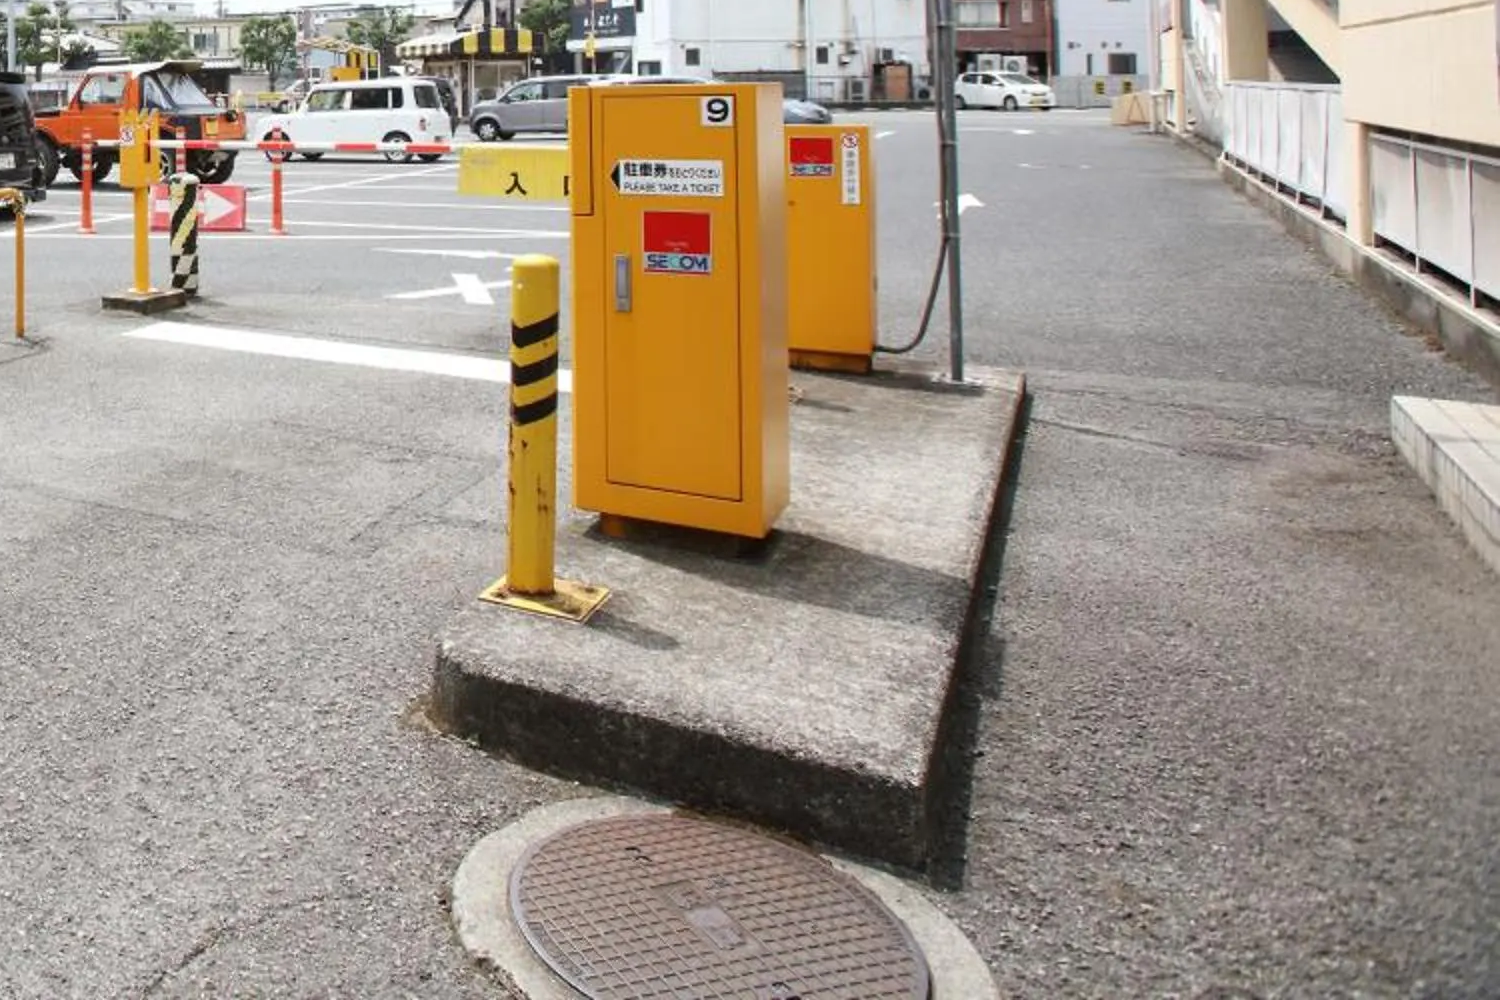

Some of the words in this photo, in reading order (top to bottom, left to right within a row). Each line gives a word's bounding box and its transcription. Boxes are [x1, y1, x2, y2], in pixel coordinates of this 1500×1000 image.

[707, 99, 729, 122] 9
[658, 184, 680, 192] TAKE
[682, 184, 688, 192] A
[690, 184, 719, 193] TICKET
[647, 254, 708, 271] SECOM
